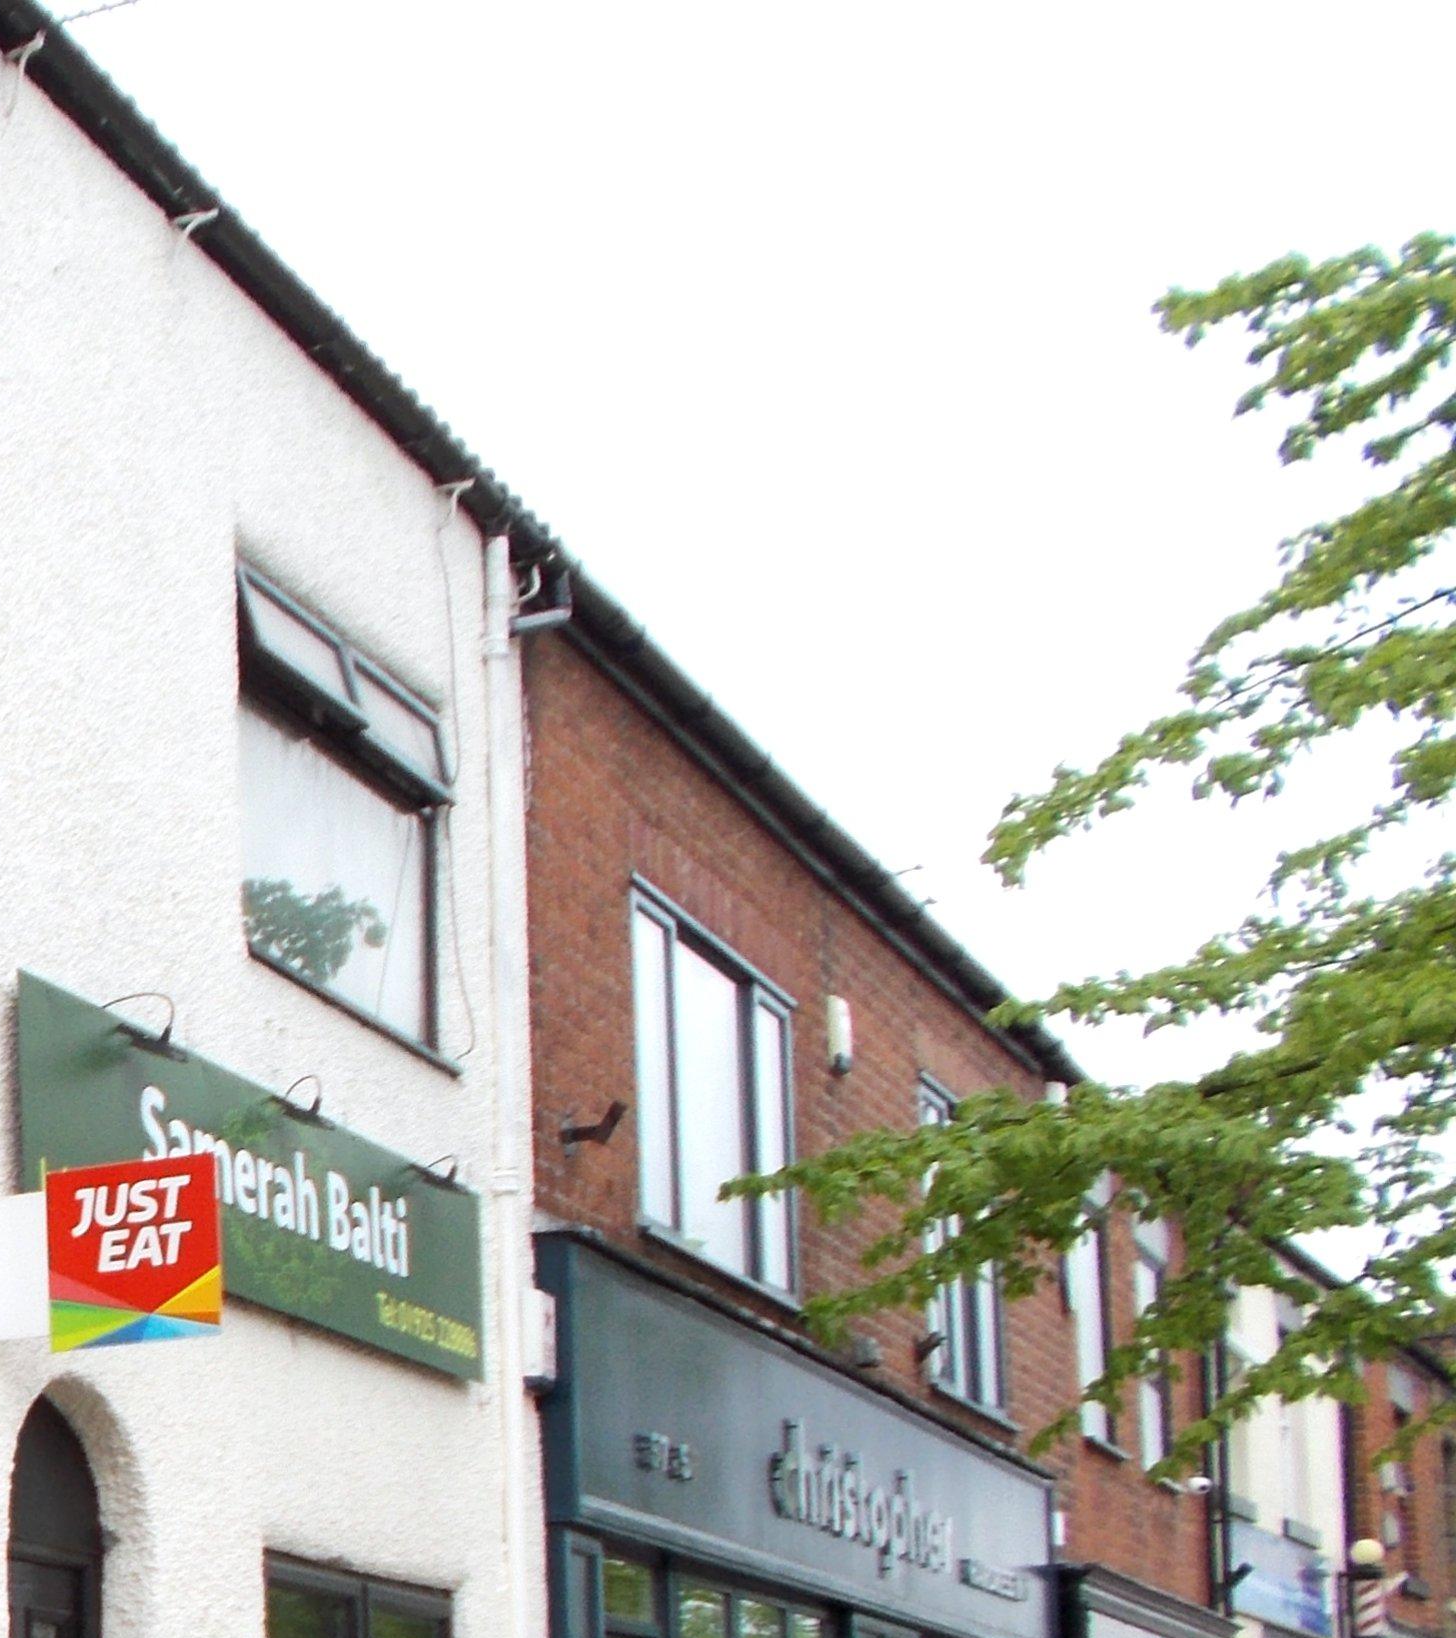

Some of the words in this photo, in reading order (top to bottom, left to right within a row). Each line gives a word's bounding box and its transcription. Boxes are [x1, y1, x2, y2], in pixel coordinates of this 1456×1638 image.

[71, 1174, 191, 1239] JUST
[327, 1170, 409, 1278] Balti
[98, 1220, 192, 1274] EAT
